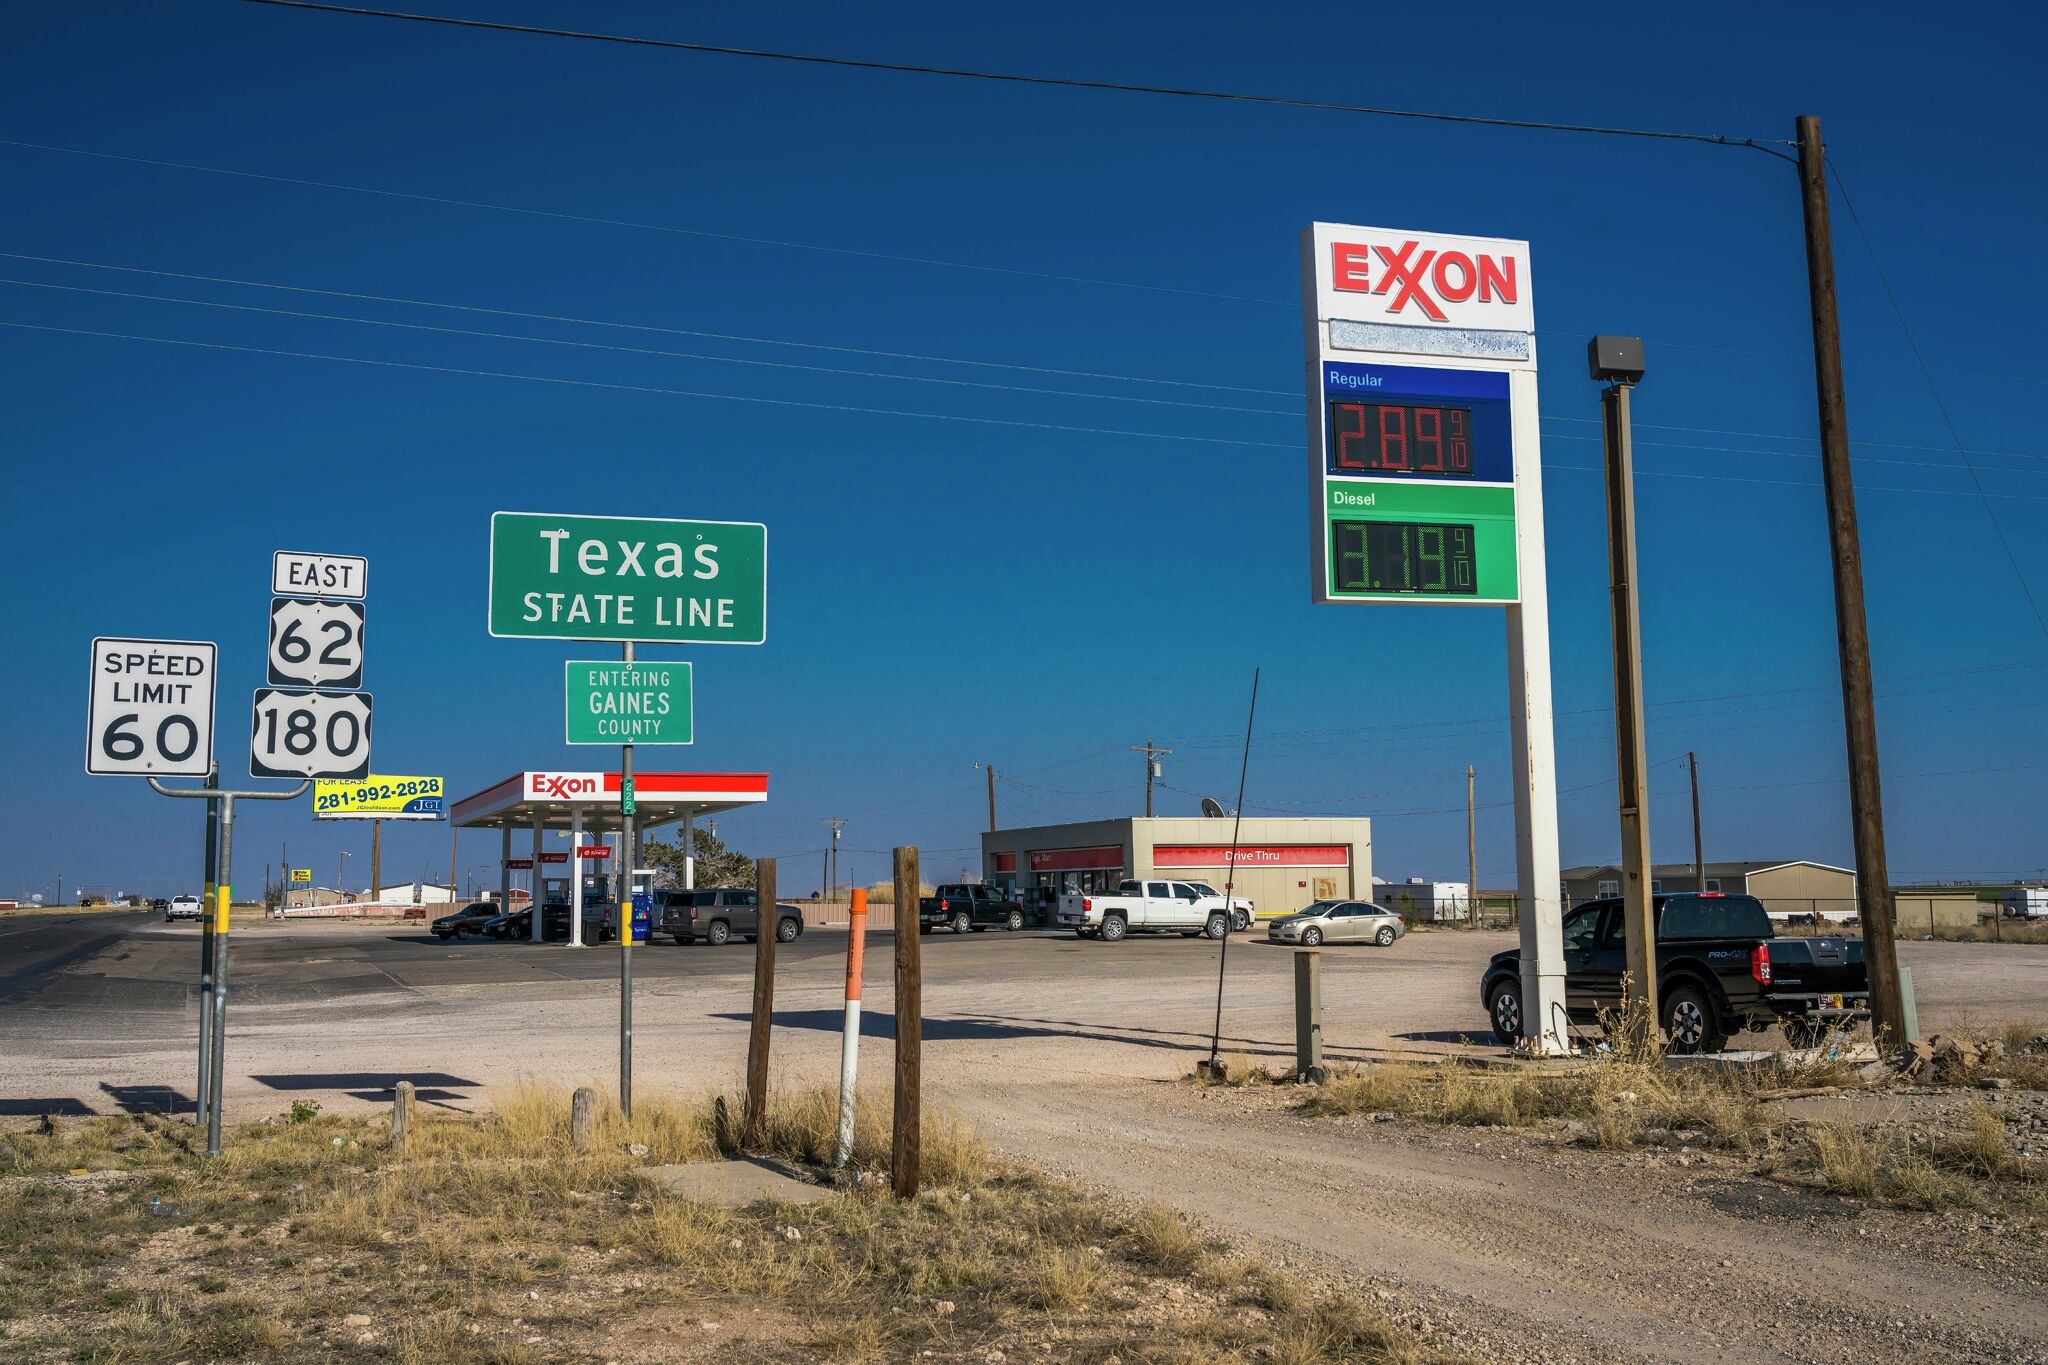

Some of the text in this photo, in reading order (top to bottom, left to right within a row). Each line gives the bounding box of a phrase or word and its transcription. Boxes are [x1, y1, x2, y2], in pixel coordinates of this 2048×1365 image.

[1331, 240, 1517, 322] EXXON
[1330, 371, 1383, 388] Regular
[1339, 404, 1443, 471] 2.89
[1334, 491, 1376, 506] Diesel
[540, 530, 719, 580] Texas
[1343, 524, 1446, 590] 3.19
[289, 562, 353, 588] EAST
[523, 592, 734, 628] STATE LINE
[278, 618, 353, 666] 62
[104, 652, 204, 676] SPEED
[589, 670, 670, 687] ENTERING
[113, 682, 193, 704] LIMIT
[589, 691, 670, 715] GAINES
[102, 713, 199, 762] 60
[264, 708, 360, 757] 180
[598, 719, 662, 735] COUNTY
[318, 778, 440, 810] 281-992-2828
[532, 774, 596, 799] Exxon
[1225, 850, 1280, 861] Drive Thru
